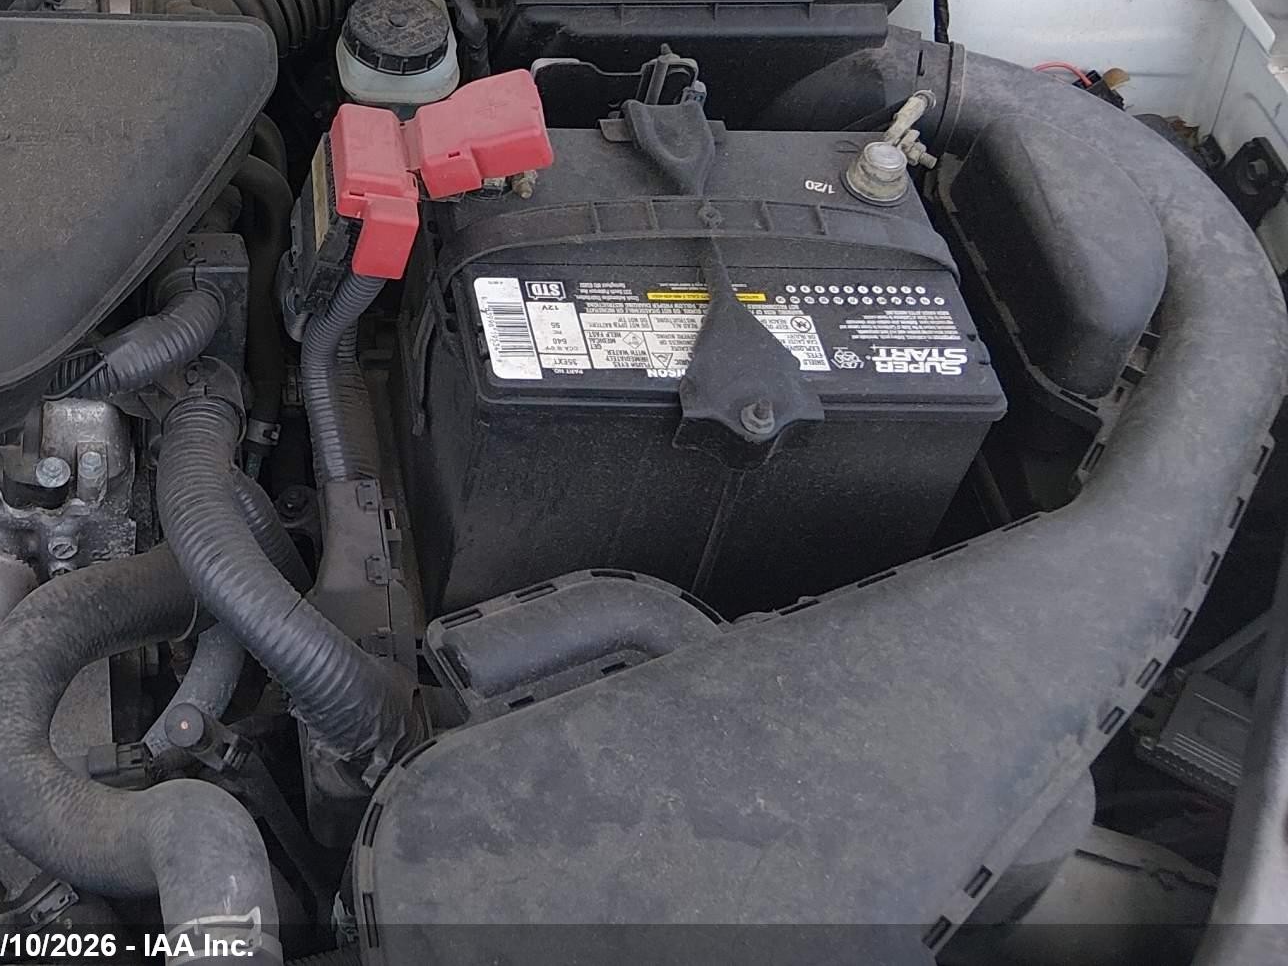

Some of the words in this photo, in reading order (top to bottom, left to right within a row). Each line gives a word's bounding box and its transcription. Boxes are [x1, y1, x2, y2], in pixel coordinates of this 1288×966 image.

[805, 180, 835, 194] 1/20
[531, 284, 560, 296] STD
[872, 348, 968, 363] START
[876, 361, 962, 375] SUPER
